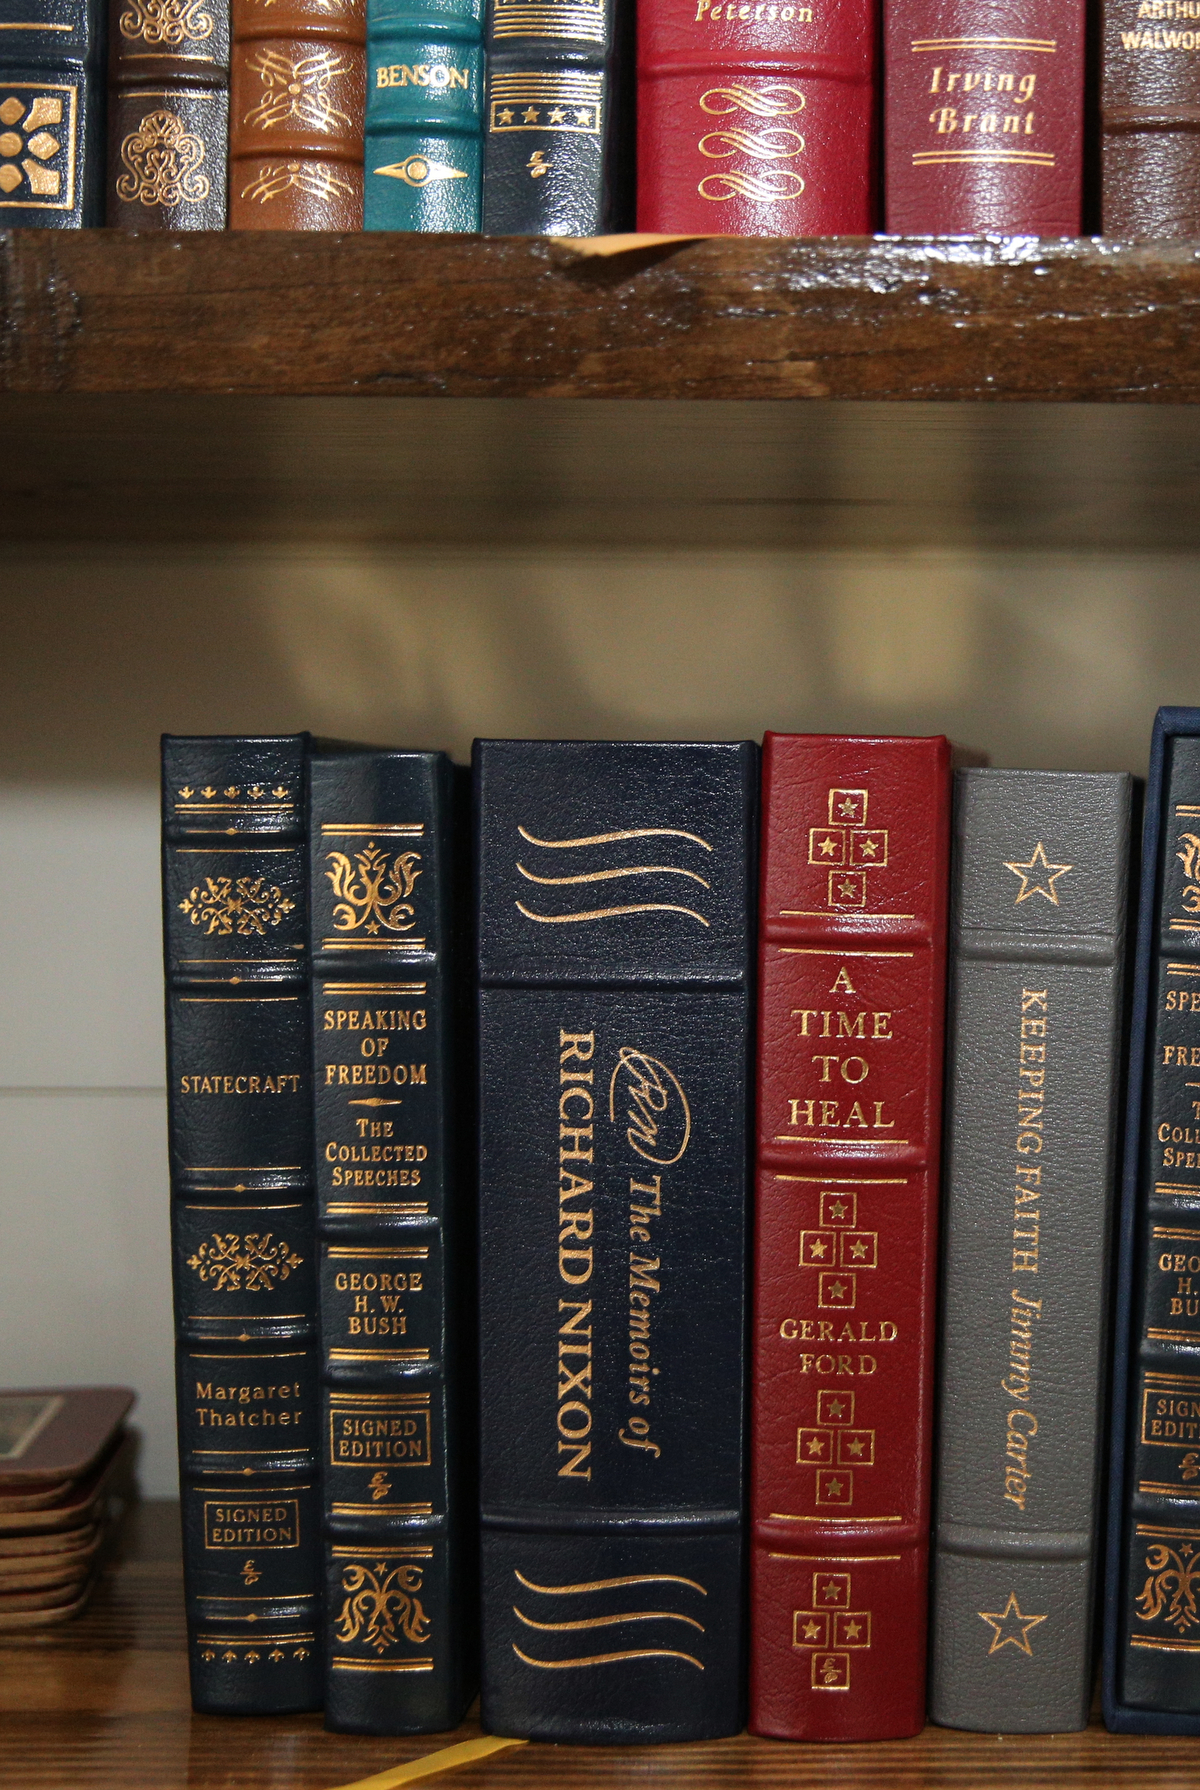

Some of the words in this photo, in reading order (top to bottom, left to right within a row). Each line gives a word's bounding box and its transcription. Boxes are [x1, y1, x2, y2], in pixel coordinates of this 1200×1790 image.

[695, 0, 813, 23] Peterson
[376, 64, 469, 90] BENSON
[928, 66, 1037, 103] Irving
[928, 107, 1035, 135] Brant
[828, 965, 857, 995] A
[323, 1009, 427, 1031] SPEAKING
[791, 1009, 893, 1040] TIME
[360, 1037, 389, 1058] OF
[324, 1064, 428, 1086] FREEDOM
[811, 1054, 870, 1084] TO
[1015, 988, 1049, 1155] KEEPING
[180, 1074, 301, 1094] STATECRAFT
[787, 1099, 896, 1129] HEAL
[325, 1141, 428, 1162] COLLECTED
[556, 1028, 596, 1286] RICHARD
[331, 1166, 421, 1187] SPEECHES
[628, 1175, 661, 1243] The
[1012, 1164, 1042, 1275] FAITH
[335, 1272, 423, 1292] GEORGE
[1177, 1277, 1199, 1296] H.
[354, 1295, 375, 1313] H.
[379, 1295, 404, 1313] W.
[347, 1316, 407, 1335] BUSH
[628, 1252, 661, 1407] Memoirs
[779, 1317, 898, 1343] GERALD
[1001, 1288, 1043, 1403] Jimmy
[799, 1353, 878, 1377] FORD
[196, 1381, 301, 1402] Margaret
[556, 1299, 594, 1482] NIXON
[195, 1407, 302, 1427] Thatcher
[342, 1418, 418, 1437] SIGNED
[338, 1439, 423, 1457] EDITION
[618, 1416, 661, 1459] of
[1003, 1408, 1038, 1511] Carter
[214, 1506, 288, 1523] SIGNED
[212, 1526, 293, 1543] EDITION
